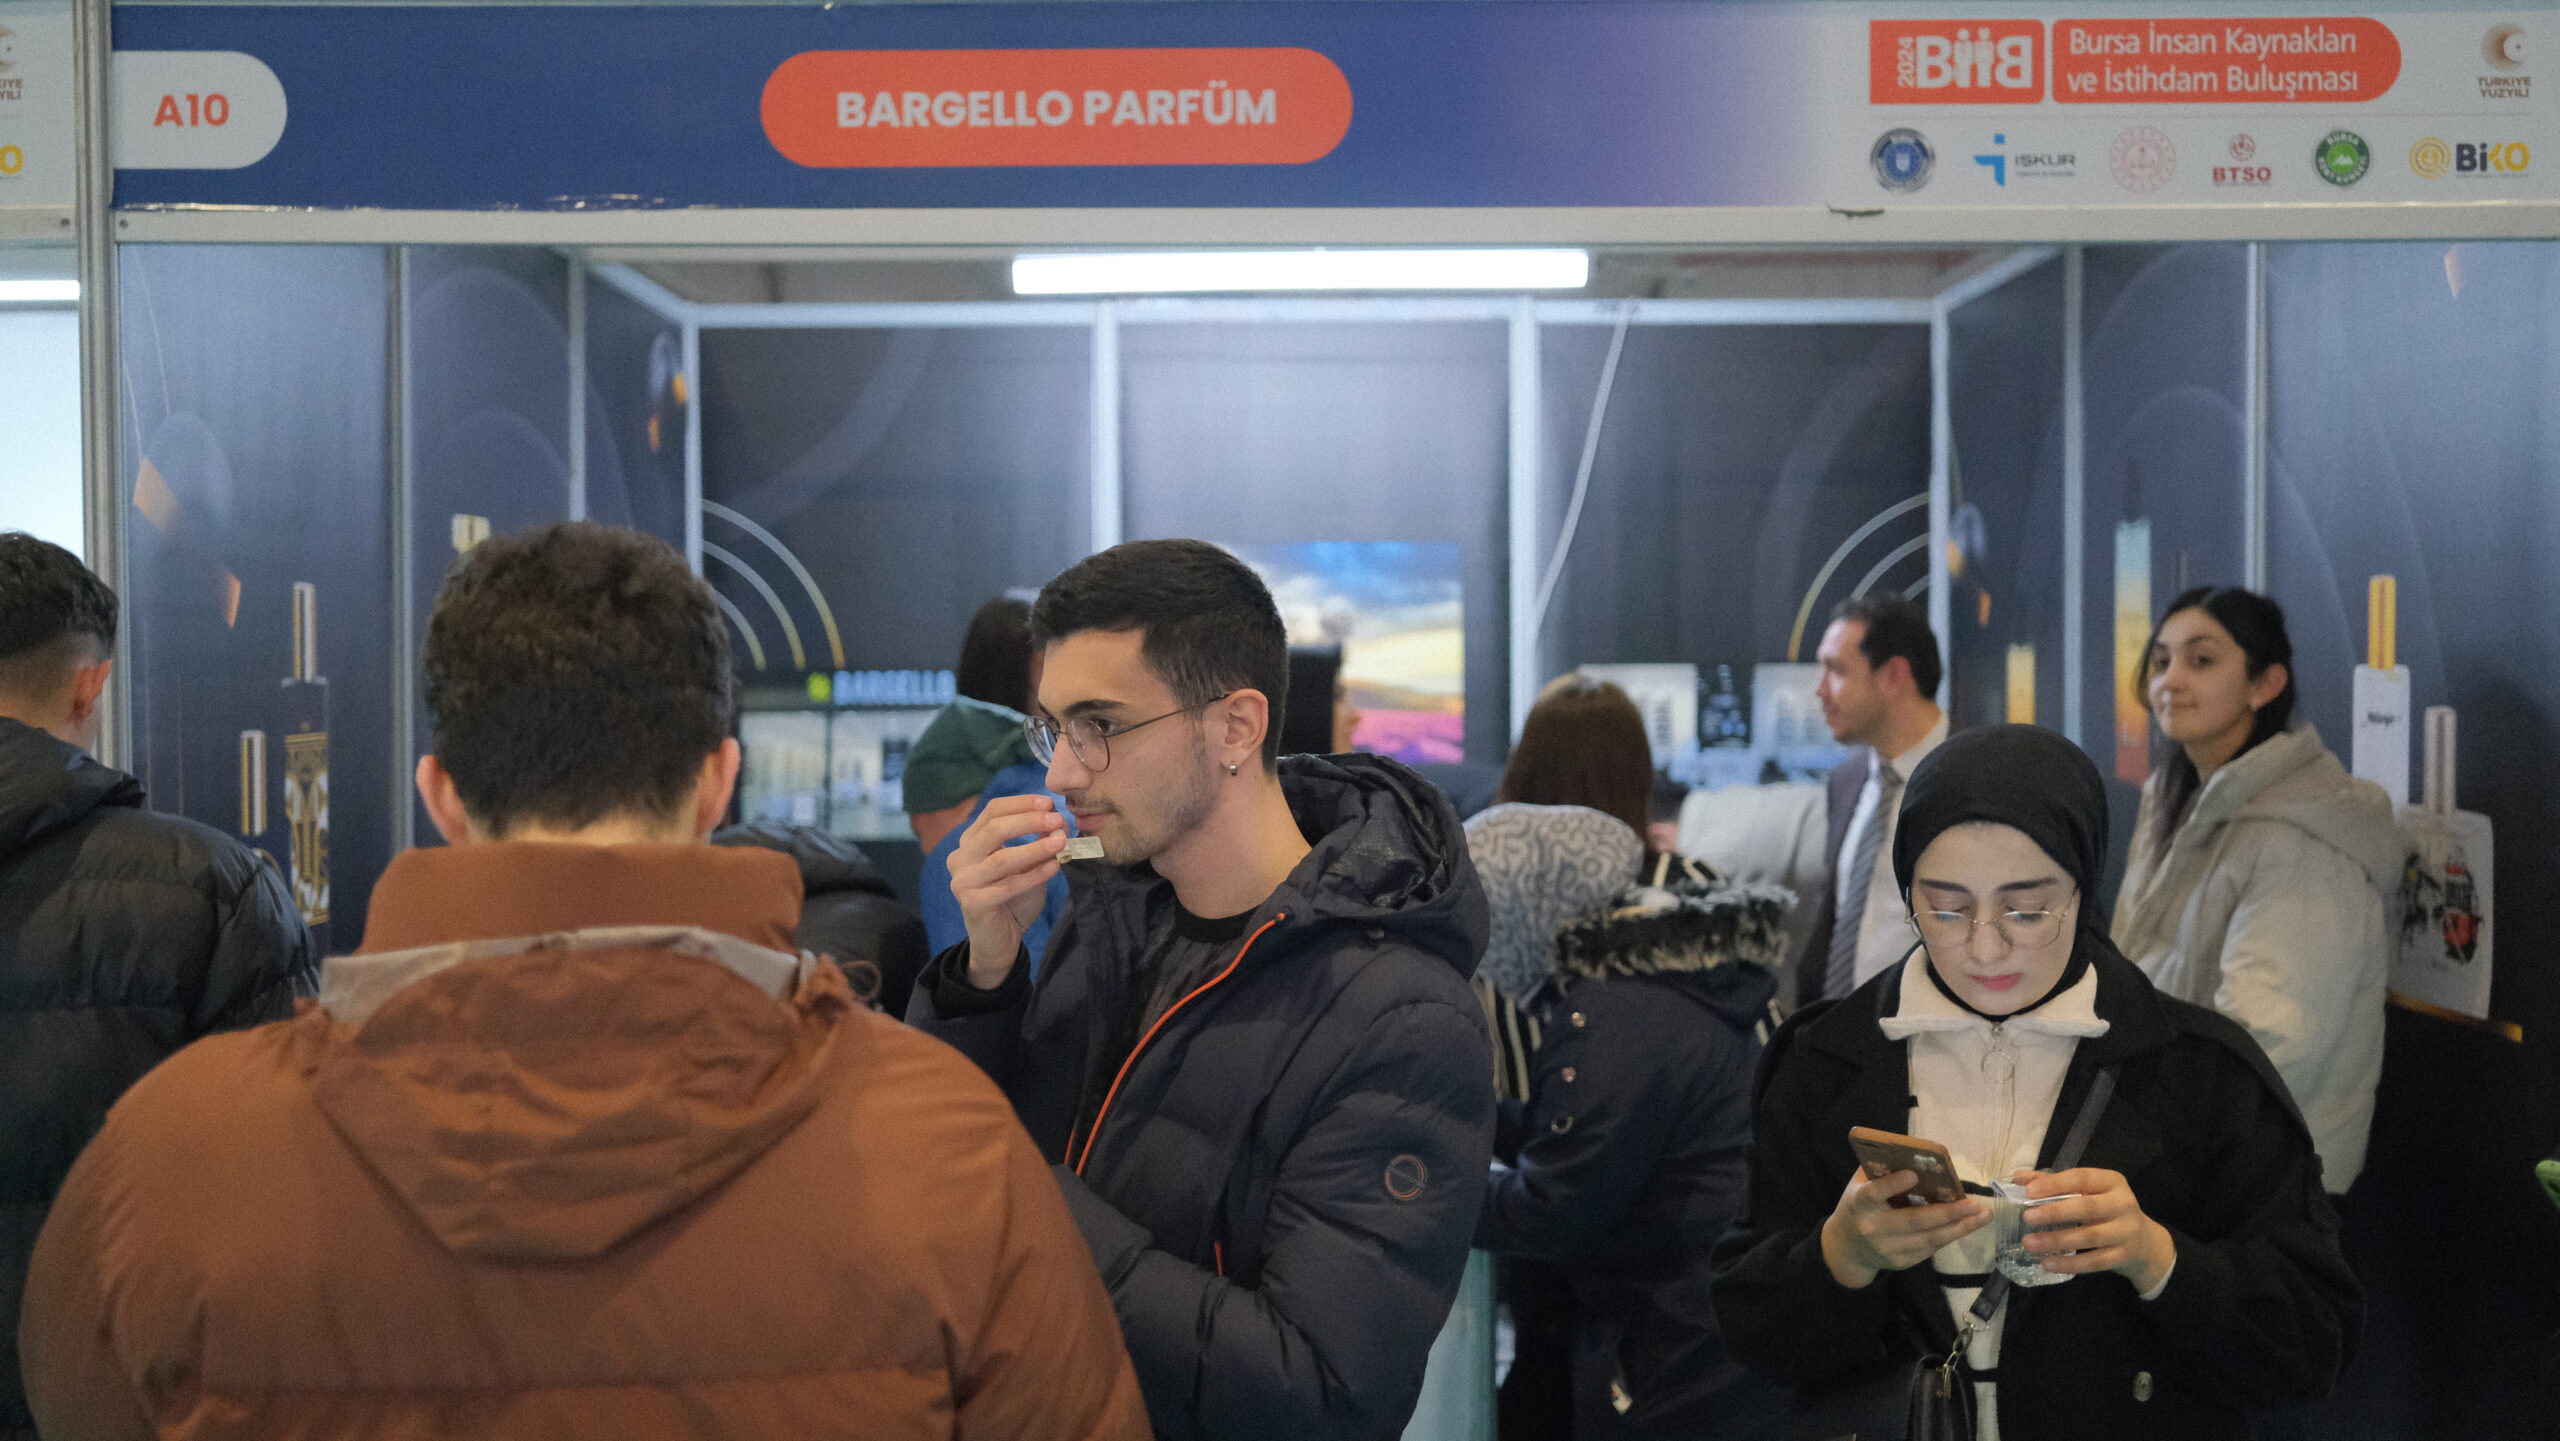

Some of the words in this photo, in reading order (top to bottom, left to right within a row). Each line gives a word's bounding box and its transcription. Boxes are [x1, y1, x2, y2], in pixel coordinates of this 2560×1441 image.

[2070, 28, 2140, 54] Bursa
[2149, 22, 2216, 53] İnsan
[2226, 25, 2356, 60] Kaynakları
[1897, 36, 1914, 88] 2024
[2068, 72, 2096, 92] ve
[2105, 60, 2217, 92] İstihdam
[2227, 65, 2357, 98] Buluşması
[154, 93, 229, 127] A10
[836, 92, 1072, 128] BARGELLO
[1084, 80, 1277, 125] PARFÜM
[2212, 167, 2272, 183] BTSO
